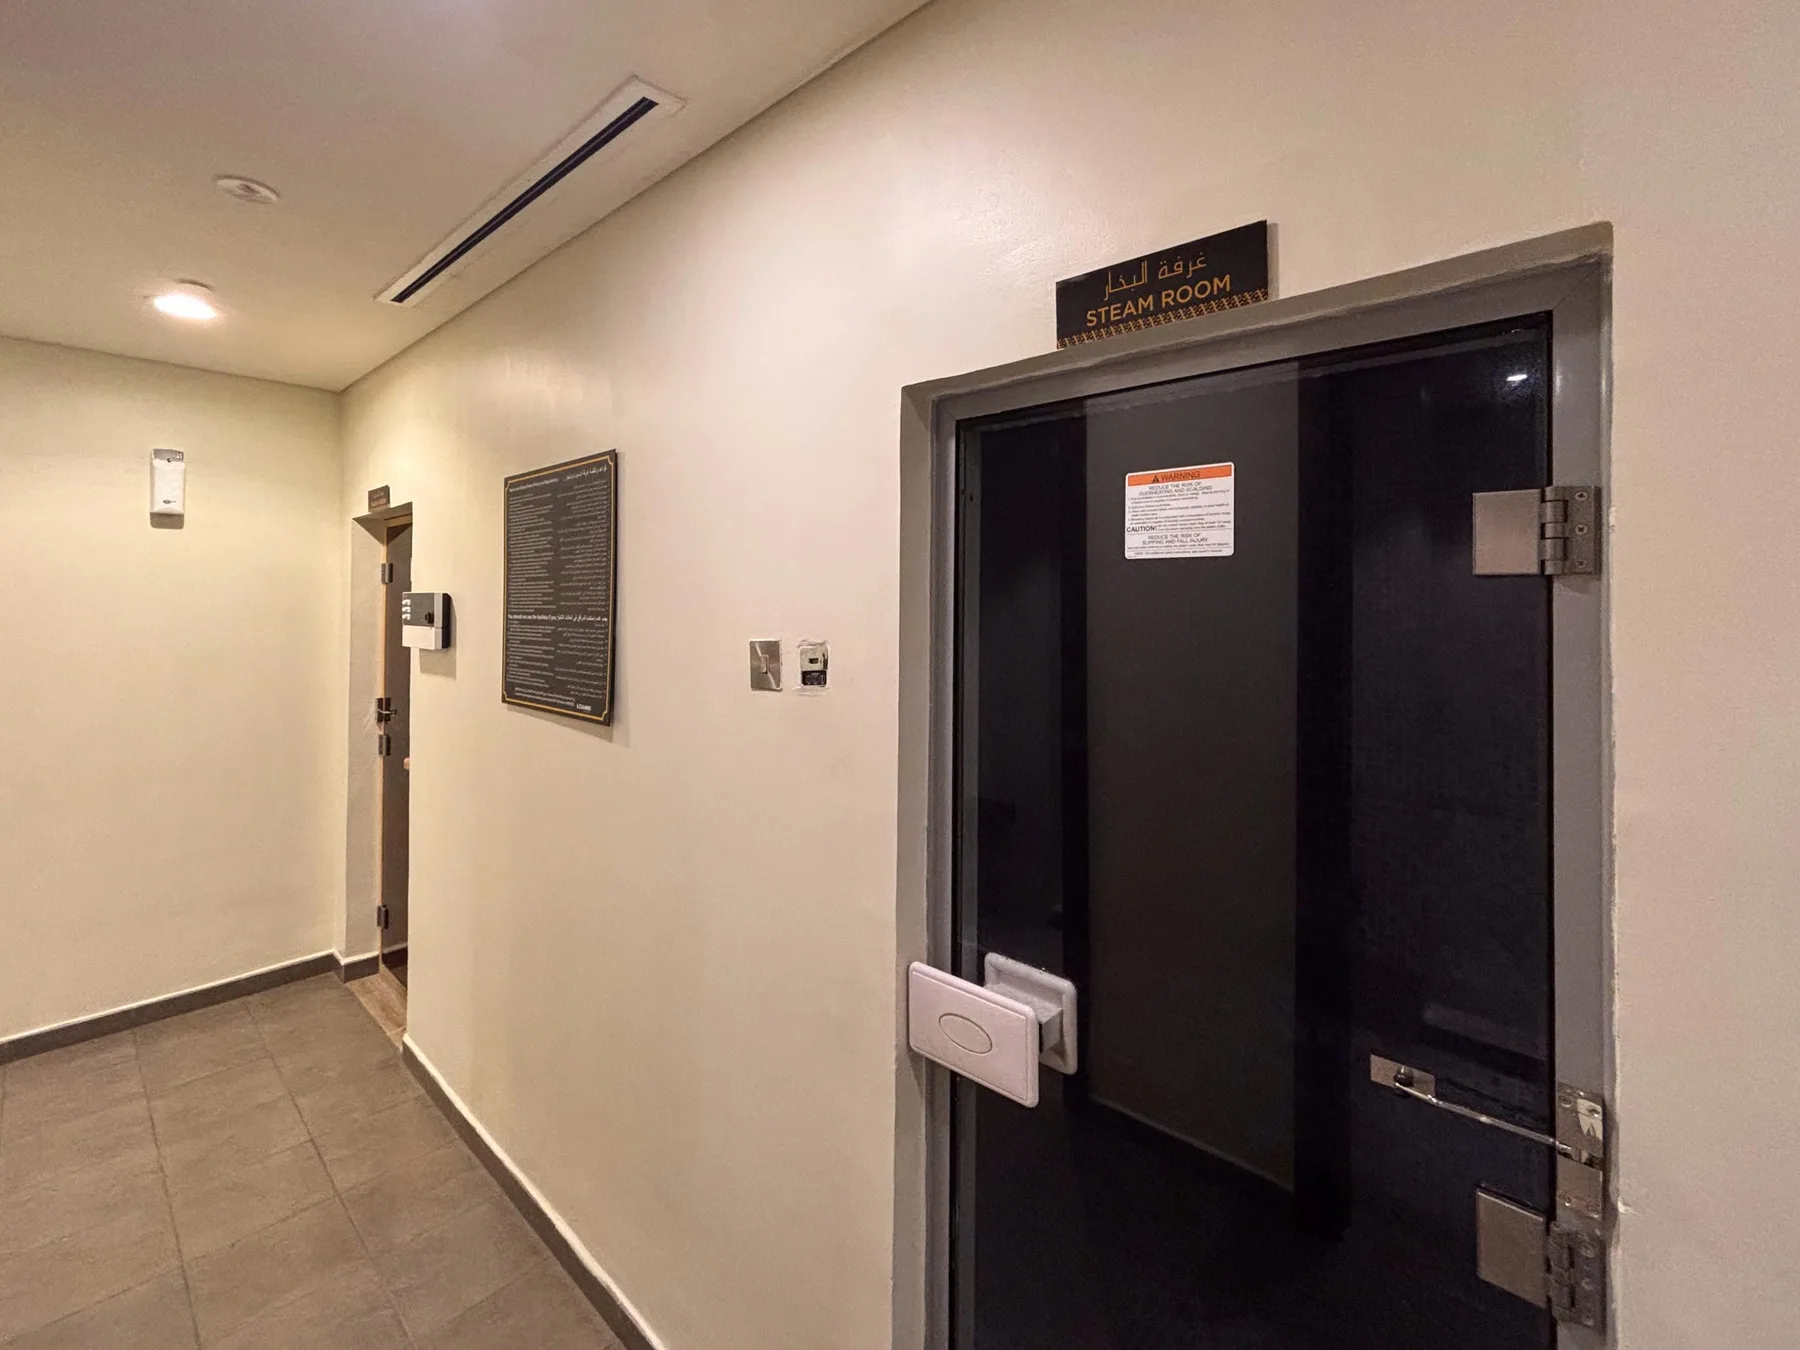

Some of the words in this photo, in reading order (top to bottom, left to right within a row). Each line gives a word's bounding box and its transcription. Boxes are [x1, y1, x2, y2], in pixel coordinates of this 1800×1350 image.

[1158, 251, 1208, 280] غرفة
[1103, 259, 1148, 301] البخار
[1086, 294, 1154, 327] STEAM
[1161, 274, 1231, 309] ROOM
[1161, 471, 1200, 481] WARNING
[1186, 485, 1213, 493] SCALDING
[1126, 525, 1158, 533] CAUTION!
[1142, 538, 1165, 546] SLIPPING
[1189, 536, 1209, 544] INJURY
